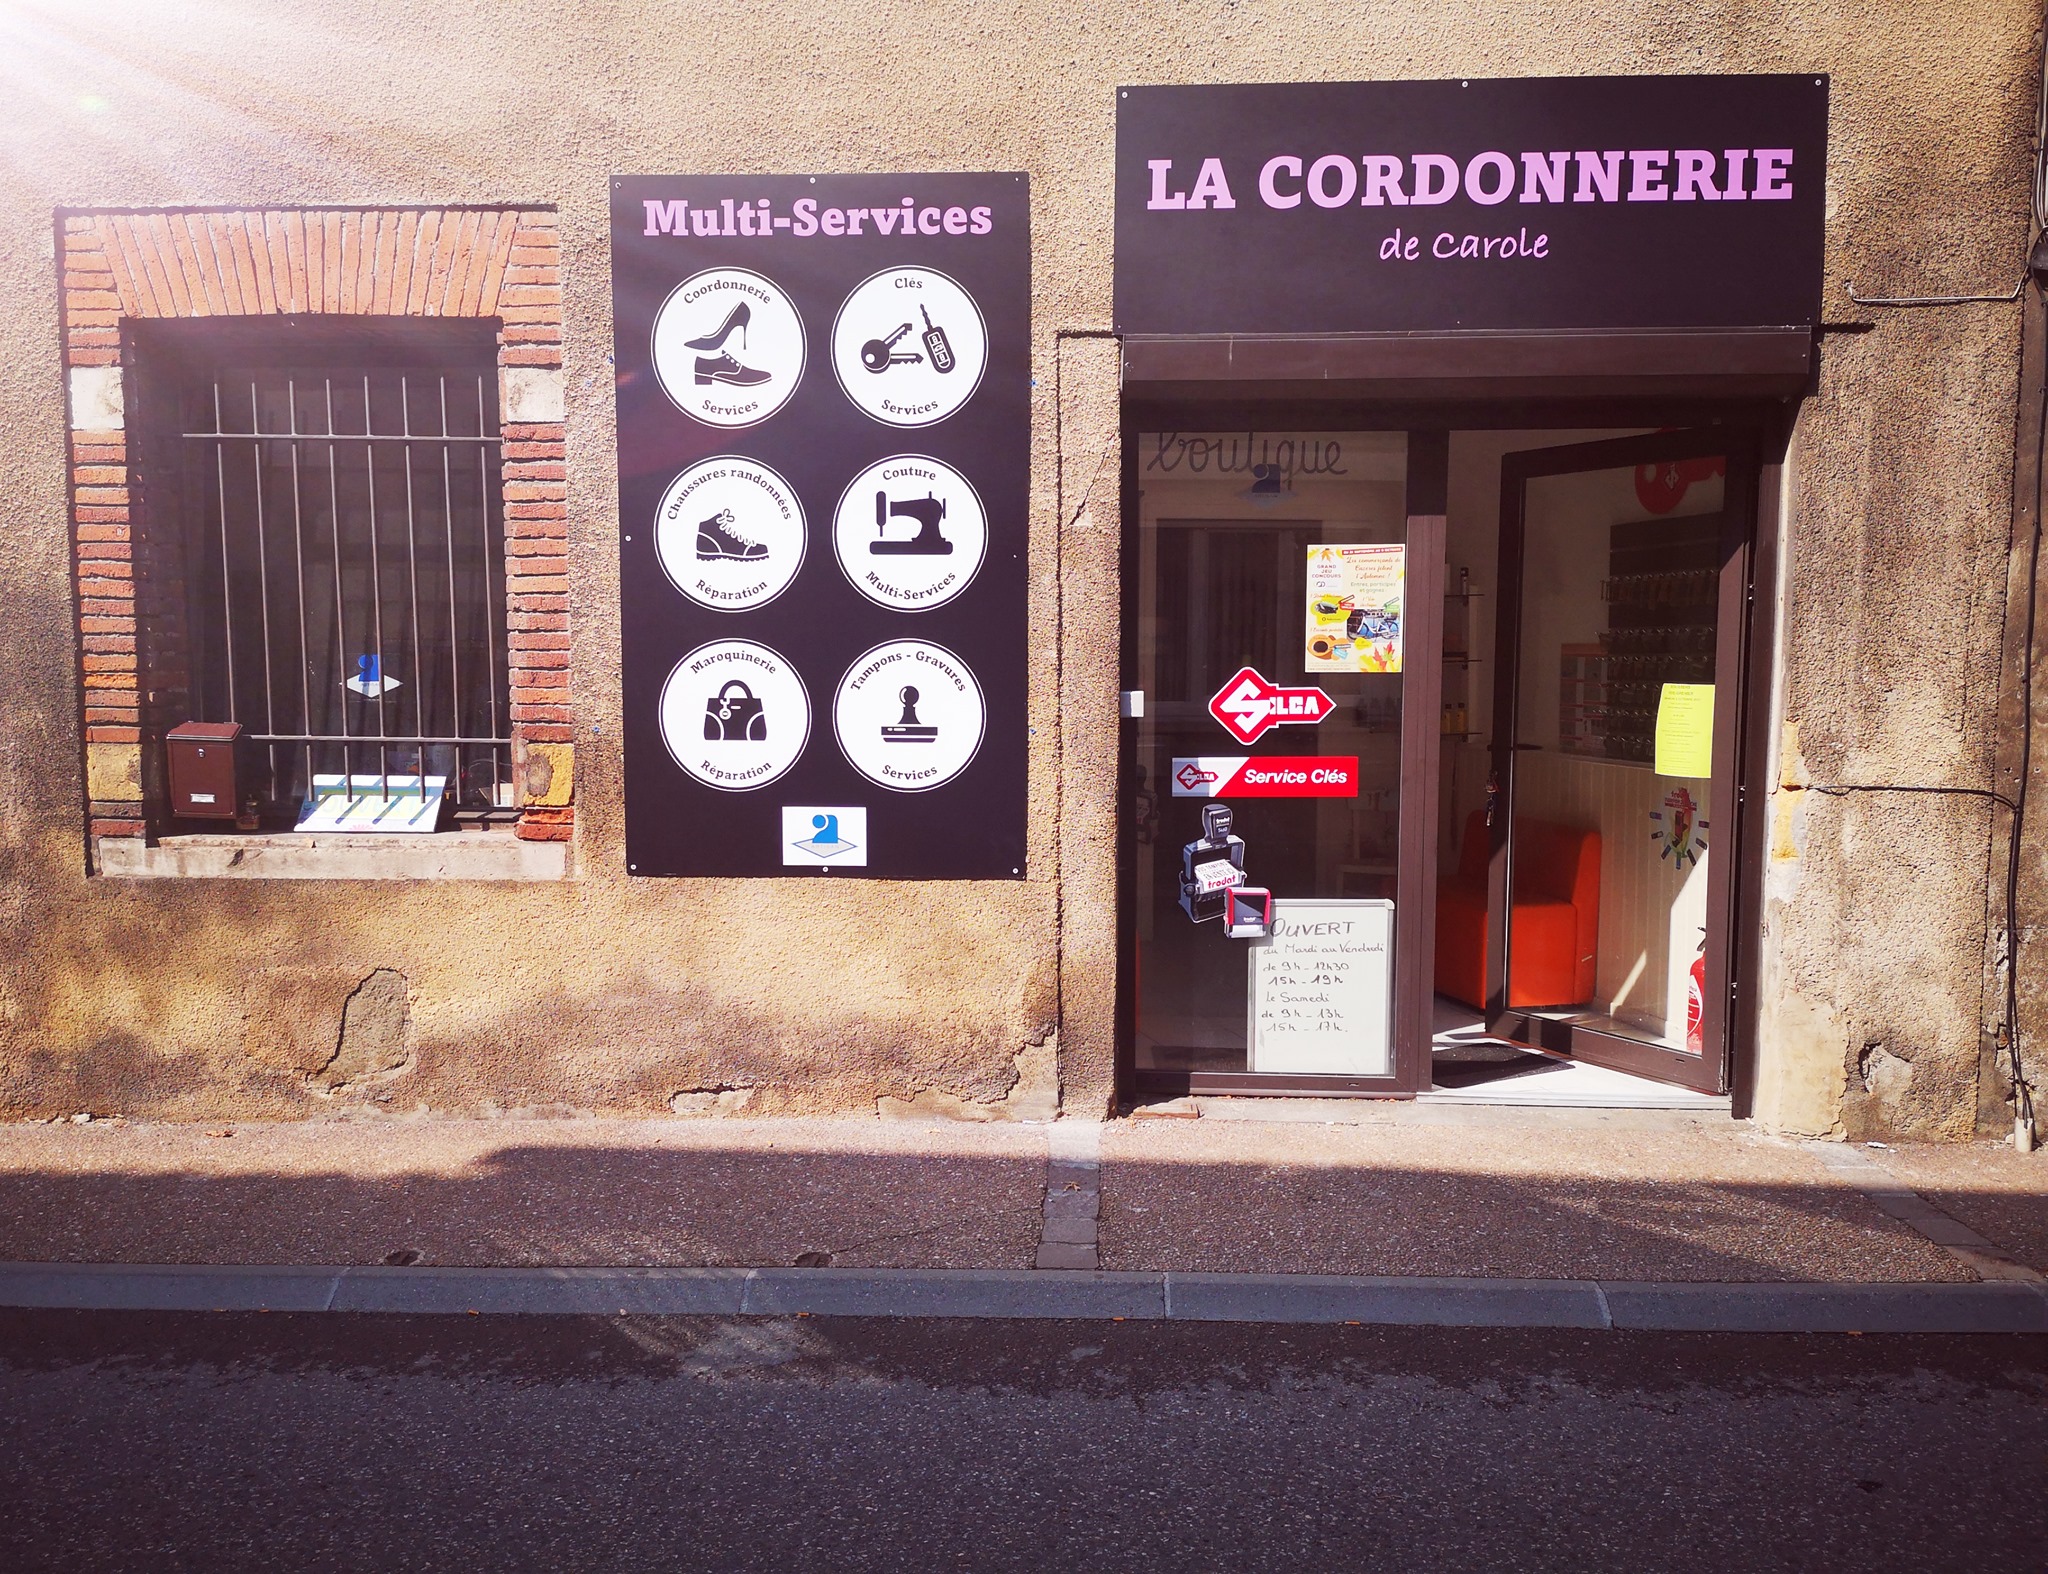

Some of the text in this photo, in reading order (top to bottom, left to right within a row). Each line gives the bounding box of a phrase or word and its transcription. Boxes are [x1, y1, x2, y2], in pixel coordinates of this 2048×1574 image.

[1146, 148, 1794, 210] LA CORDONNERIE
[643, 197, 992, 237] Multi-Services
[1379, 228, 1550, 261] de Carole
[683, 279, 771, 305] Coordonnerie
[894, 277, 923, 290] Clés
[702, 399, 759, 416] Services
[881, 399, 939, 416] Services
[882, 468, 936, 483] Couture
[667, 468, 792, 521] Chaussures randonnées
[696, 579, 768, 600] Réparation
[864, 571, 956, 600] Multi-Services
[690, 650, 777, 675] Maroquinerie
[850, 651, 903, 693] Tampons
[915, 651, 967, 693] Gravures
[1219, 678, 1320, 734] SILCA
[700, 760, 772, 780] Réparation
[882, 764, 939, 780] Services
[1244, 768, 1307, 784] Service
[1311, 768, 1348, 784] Clés
[1208, 875, 1236, 889] trodat
[1270, 917, 1356, 937] OUVERT
[1263, 945, 1278, 955] du
[1284, 943, 1317, 954] Mardi
[1263, 962, 1276, 972] de
[1314, 961, 1350, 971] 12h30
[1268, 976, 1297, 985] 15h
[1310, 974, 1343, 985] 19h
[1280, 992, 1329, 1002] Samedi
[1261, 1010, 1274, 1018] de
[1266, 1022, 1297, 1031] 15h
